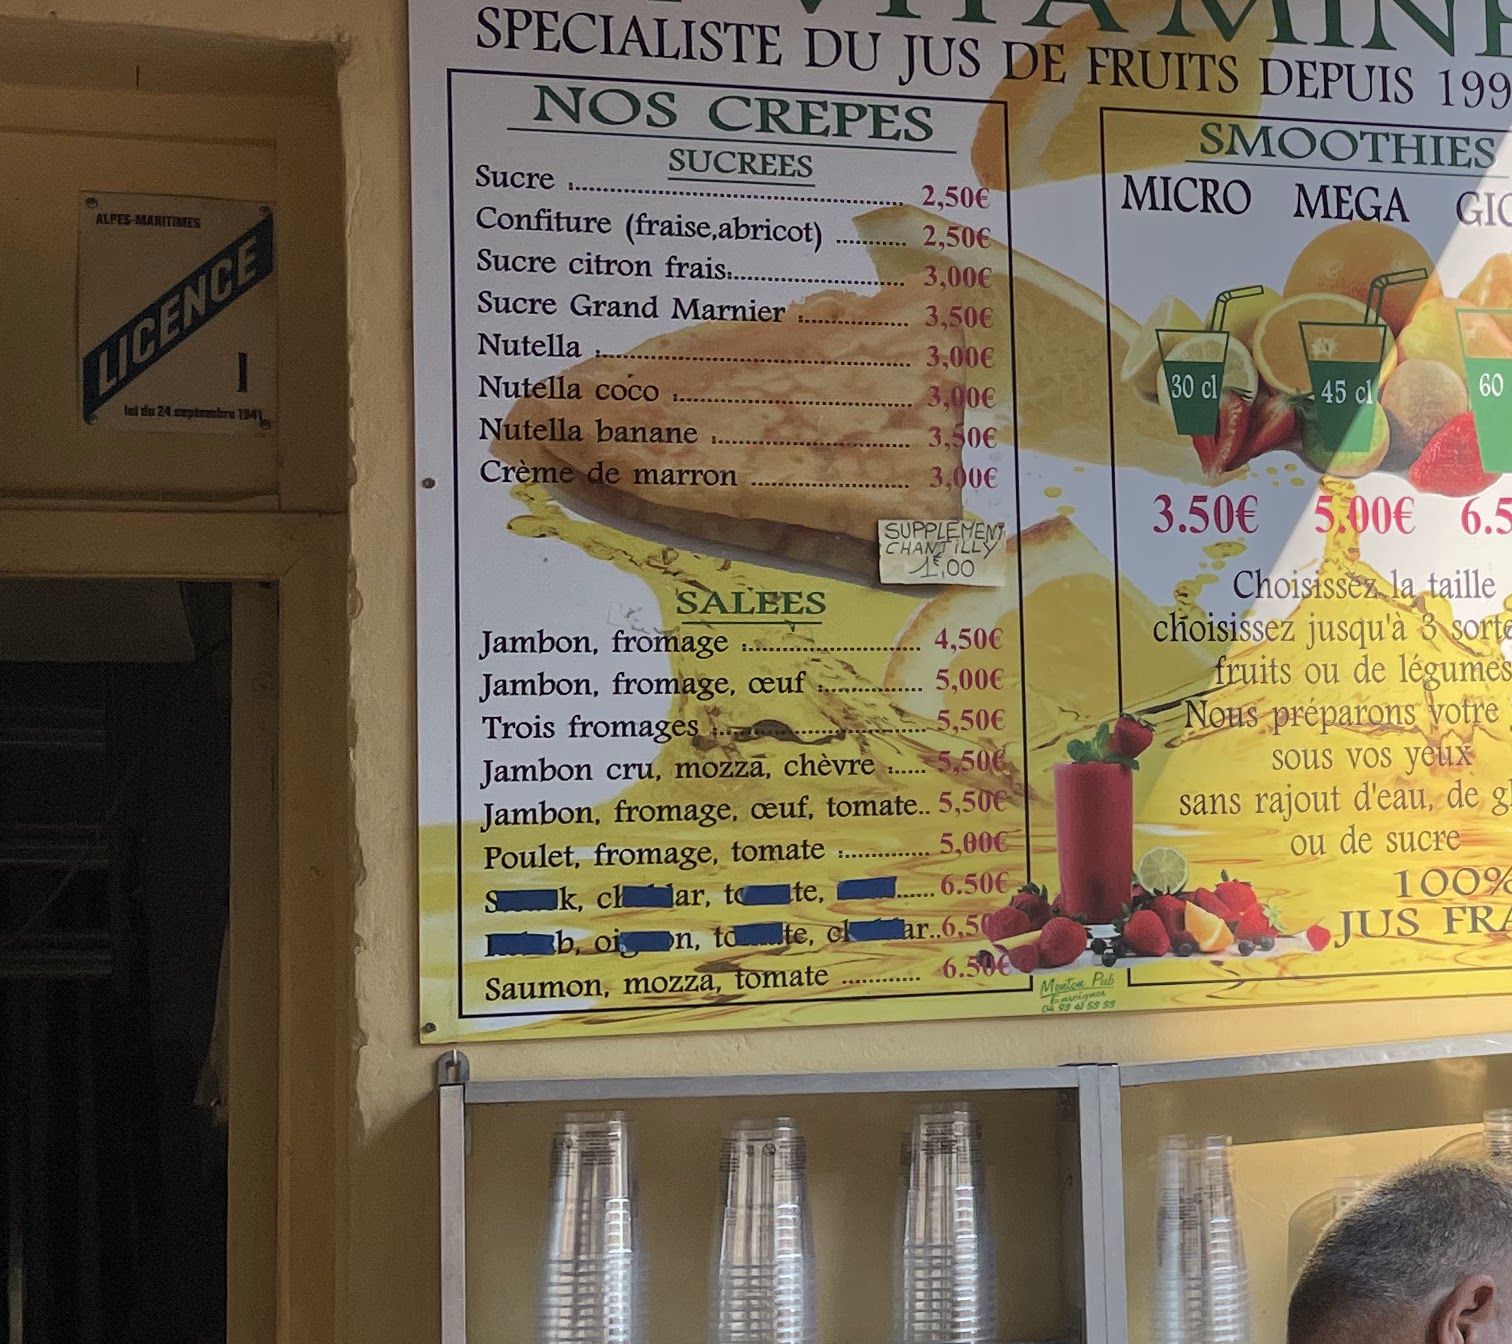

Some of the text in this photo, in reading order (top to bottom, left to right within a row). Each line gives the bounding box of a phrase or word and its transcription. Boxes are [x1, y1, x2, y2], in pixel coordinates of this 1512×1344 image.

[475, 7, 782, 66] SPECIALISTE
[806, 28, 881, 71] DU
[899, 35, 981, 85] JUS
[1004, 41, 1066, 85] DE
[1087, 47, 1239, 95] FRUITS
[1260, 57, 1414, 104] DEPUIS
[534, 84, 933, 142] NOS CREPES
[1200, 121, 1497, 169] SMOOTHIES
[668, 148, 813, 179] SUCREES
[475, 164, 991, 210] Sucre 2,50€
[1121, 174, 1252, 215] MICRO
[1293, 183, 1410, 223] MEGA
[476, 206, 992, 253] Confiture (fraise,abricot) 2,50€
[476, 248, 557, 276] Sucre
[568, 253, 653, 279] citron
[922, 265, 992, 292] 3,00€
[99, 236, 257, 397] LICENCE
[477, 290, 993, 331] Sucre Grand Marnier 3,50€
[478, 333, 994, 371] Nutella 3,00€
[478, 376, 996, 411] Nutella coco 3,00€
[1171, 373, 1218, 400] 30 cl
[1320, 377, 1372, 404] 45 cl
[1479, 372, 1504, 397] 60
[479, 418, 998, 451] Nutella banane 3,50€
[479, 460, 999, 491] Crème de marron 3,00€
[885, 521, 1005, 543] SUPPLEMENT
[1153, 493, 1260, 535] 3.50€
[1314, 495, 1416, 536] 5.00€
[1233, 569, 1495, 599] Choisissez la taille
[676, 590, 827, 616] SALEES
[479, 628, 1003, 658] Jambon, fromage 4,50€
[1153, 612, 1294, 643] choisissez
[1307, 612, 1407, 650] jusqu'à
[1422, 612, 1438, 641] 3
[480, 668, 1004, 703] Jambon, fromage, œuf 5,00€
[1215, 656, 1292, 686] fruits
[1305, 661, 1341, 684] ou
[1353, 656, 1386, 684] de
[482, 708, 1006, 742] Trois fromages 5,50€
[1185, 700, 1259, 729] Nous
[1273, 698, 1417, 736] préparons
[1429, 696, 1499, 725] votre
[480, 749, 1006, 790] Jambon cru, mozza, chèvre 5,50€
[1272, 742, 1473, 776] sous vos yeux
[481, 802, 601, 832] Jambon,
[614, 797, 739, 828] fromage,
[751, 795, 815, 820] œuf,
[939, 790, 1008, 815] 5,50€
[1179, 790, 1241, 817] sans
[1255, 783, 1341, 821] rajout
[1353, 781, 1434, 813] d'eau,
[1448, 780, 1479, 808] de
[484, 845, 580, 872] Poulet,
[594, 840, 719, 871] fromage,
[731, 837, 826, 862] tomate
[1291, 825, 1461, 857] ou de sucre
[1335, 908, 1418, 948] JUS
[485, 973, 610, 1003] Saumon,
[624, 973, 722, 996] mozza,
[735, 966, 829, 991] tomate
[1092, 972, 1115, 986] Pub
